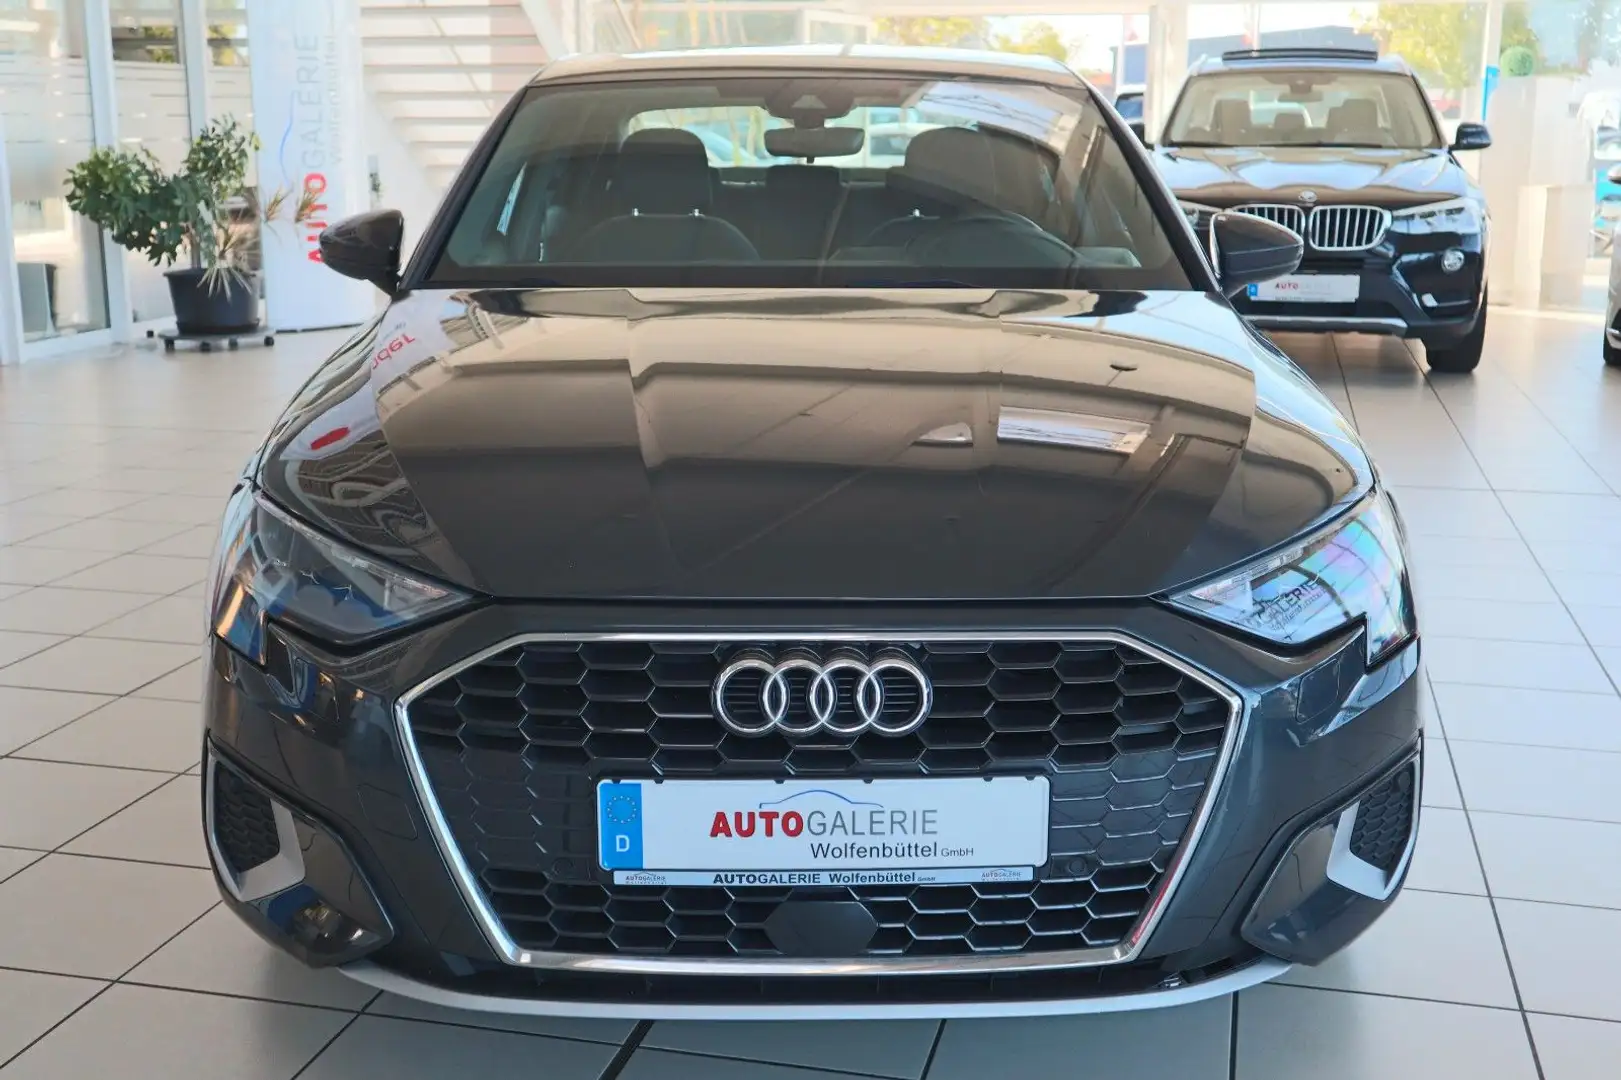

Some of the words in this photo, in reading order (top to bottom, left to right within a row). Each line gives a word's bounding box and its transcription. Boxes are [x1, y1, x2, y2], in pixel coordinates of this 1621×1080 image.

[710, 809, 938, 838] AUTOGALERIE
[615, 834, 631, 853] D
[810, 841, 938, 859] Wolfenbüttel
[941, 847, 974, 858] GmbH
[713, 873, 821, 885] AUTOGALERIE
[829, 871, 916, 884] Wolfenbüttel
